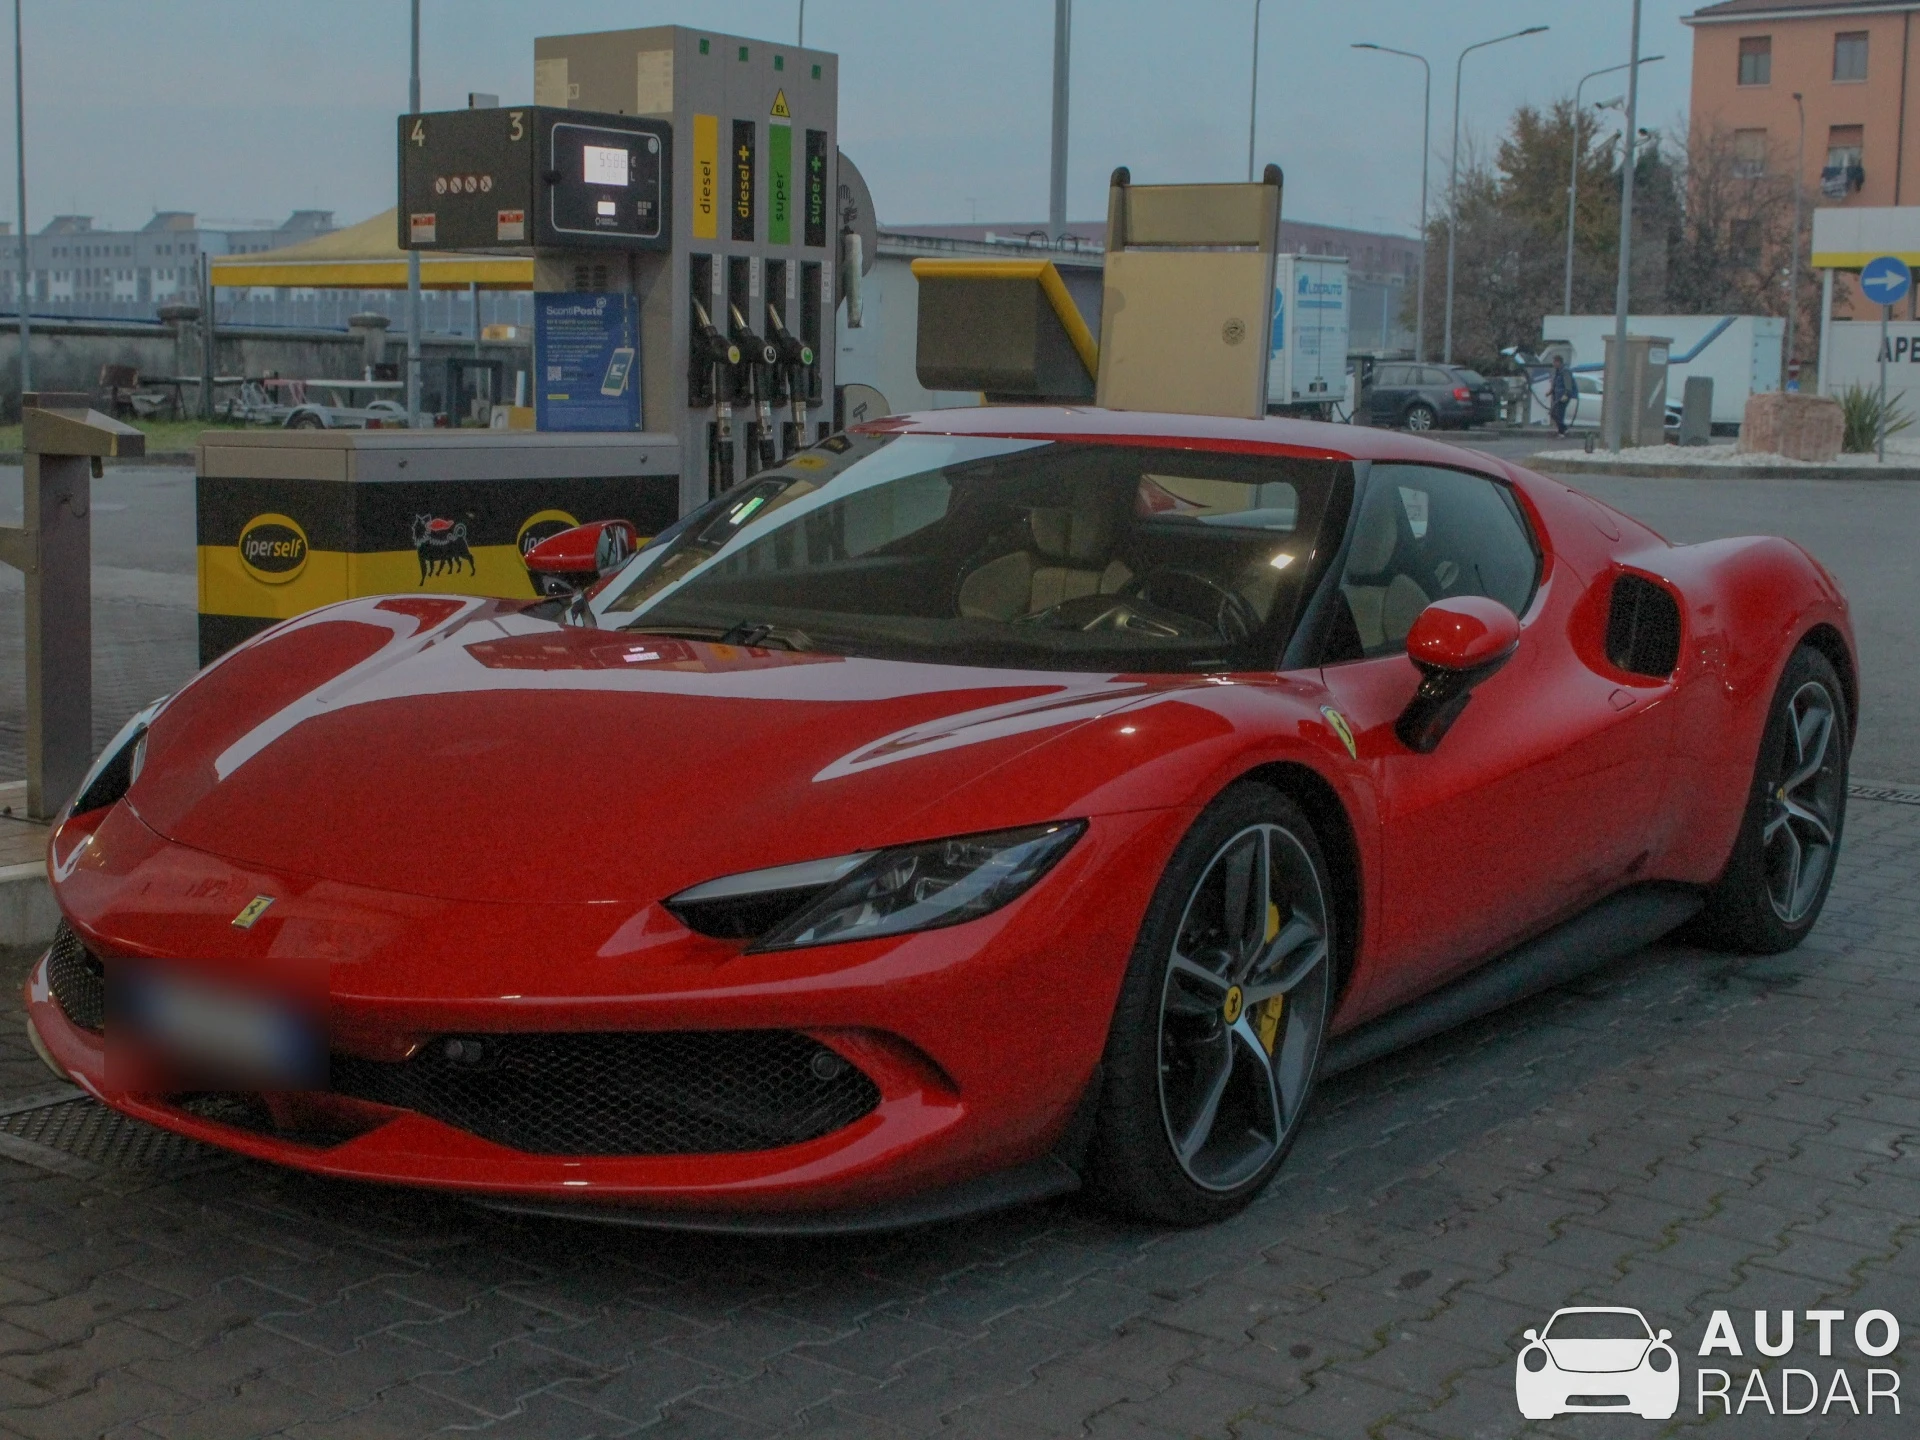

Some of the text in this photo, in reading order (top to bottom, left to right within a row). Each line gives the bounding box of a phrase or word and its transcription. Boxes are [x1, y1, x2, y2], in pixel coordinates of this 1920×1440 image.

[775, 104, 785, 114] EX
[411, 119, 425, 147] 4
[509, 112, 524, 141] 3
[700, 160, 711, 214] diesel
[775, 171, 784, 222] super
[245, 534, 302, 560] iperself
